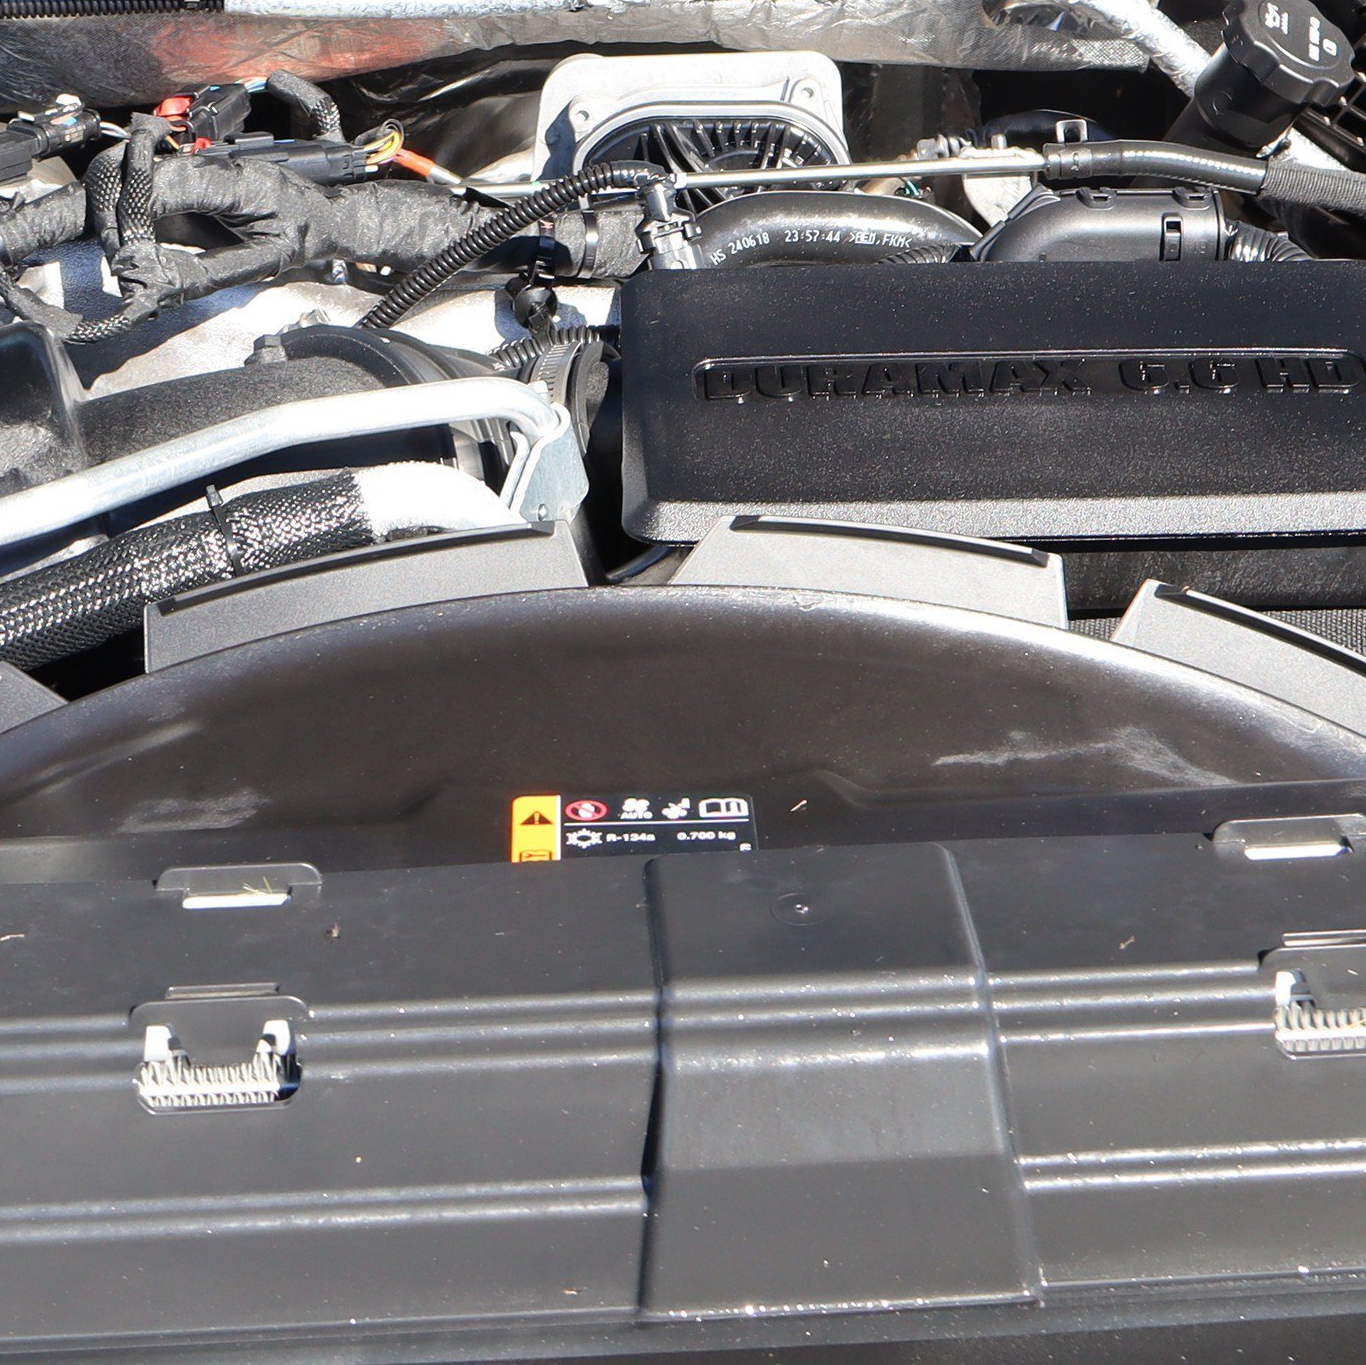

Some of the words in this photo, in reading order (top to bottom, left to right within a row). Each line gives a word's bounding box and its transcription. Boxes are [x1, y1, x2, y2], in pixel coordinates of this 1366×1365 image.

[709, 248, 727, 266] HS
[728, 232, 770, 255] 240618
[784, 230, 841, 243] 23:57:44
[704, 360, 1092, 400] DURAMAX
[1118, 357, 1241, 394] 6.6
[1254, 357, 1360, 394] HD
[620, 811, 654, 820] AUTO
[606, 832, 656, 842] R-134a
[677, 830, 716, 841] 0.700
[718, 830, 736, 841] kg
